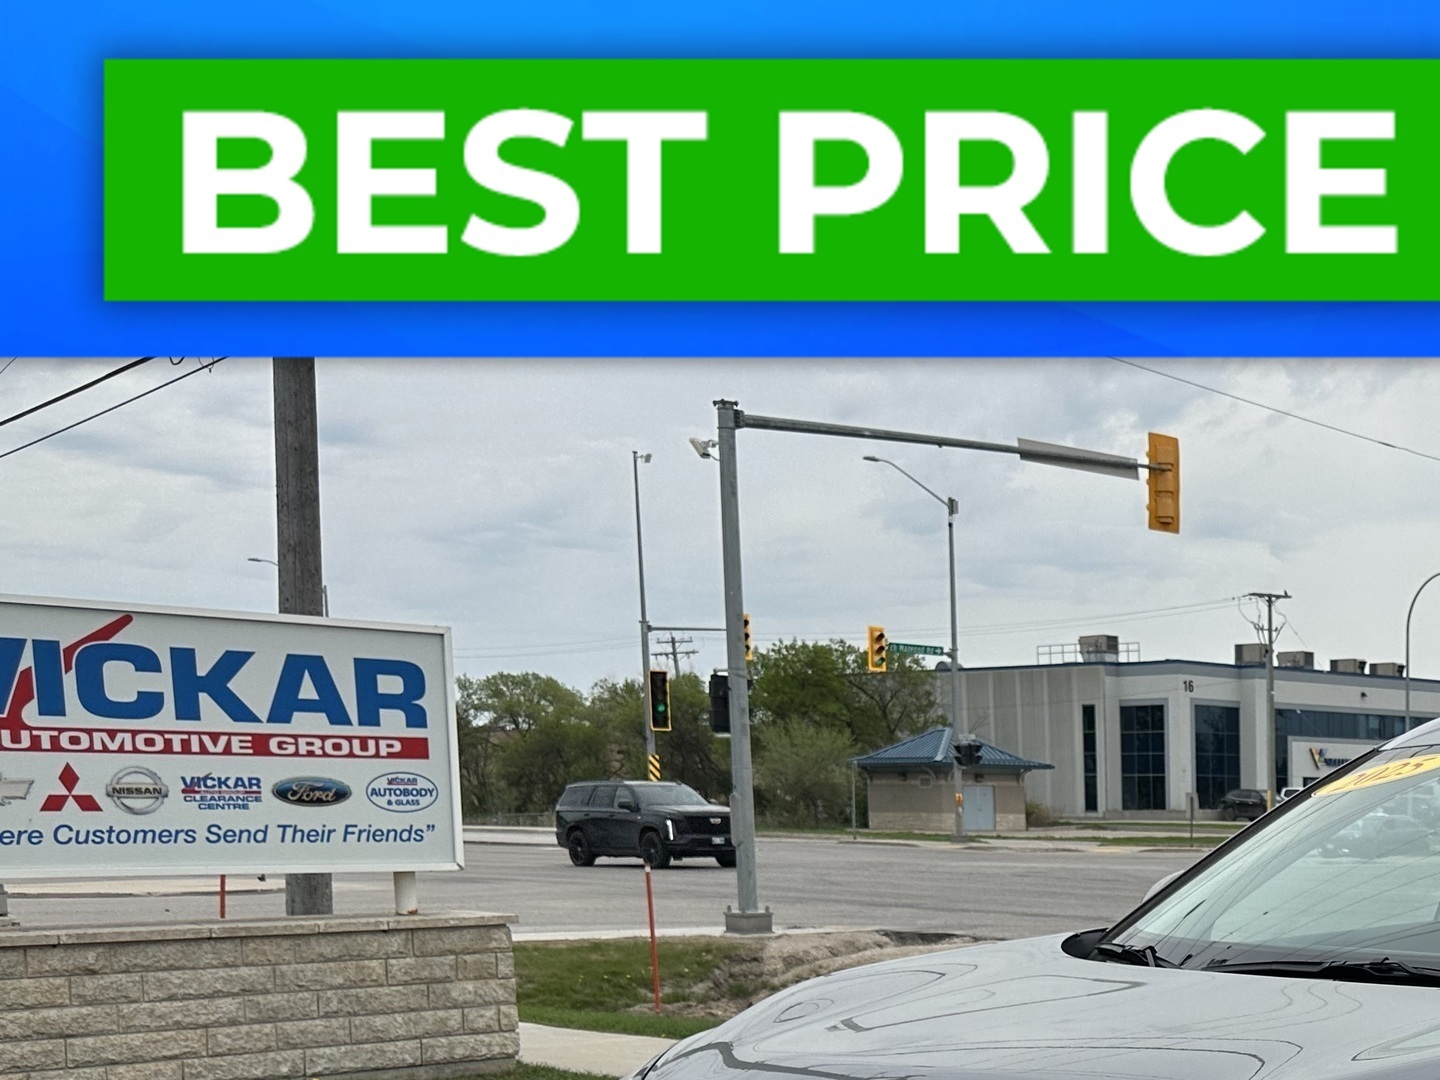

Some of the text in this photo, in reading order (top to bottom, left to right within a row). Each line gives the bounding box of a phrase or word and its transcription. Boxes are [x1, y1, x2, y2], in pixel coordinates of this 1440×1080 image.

[1183, 680, 1194, 693] 16
[0, 729, 402, 757] UTOMOTIVE GROUP
[181, 776, 262, 790] VICKAR
[112, 786, 162, 795] NISSAN
[287, 781, 337, 801] Ford
[370, 787, 435, 797] AUTOBODY
[183, 795, 263, 803] CLEARANCE
[0, 828, 44, 845] ere
[53, 824, 197, 845] Customers
[205, 824, 268, 844] Send
[277, 824, 336, 843] Their
